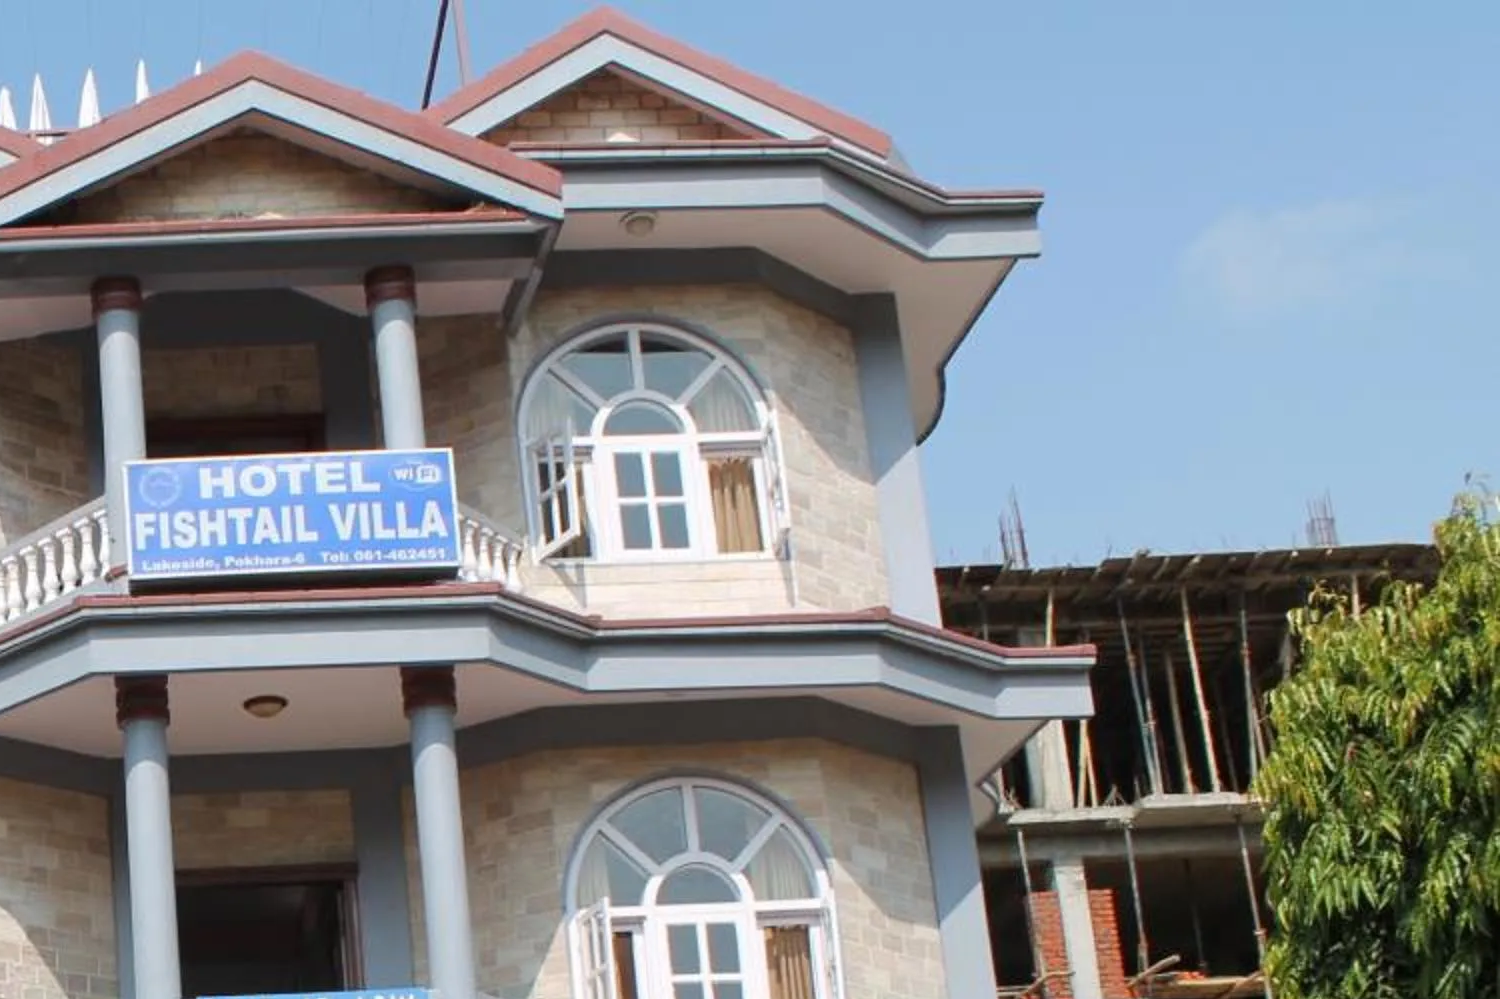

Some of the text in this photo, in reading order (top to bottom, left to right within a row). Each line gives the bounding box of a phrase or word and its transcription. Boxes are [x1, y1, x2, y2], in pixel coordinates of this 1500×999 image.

[199, 461, 381, 499] HOTEL
[134, 500, 448, 551] FISHTAIL VILLA
[141, 557, 220, 573] Lakeside,
[320, 550, 349, 564] Tel:
